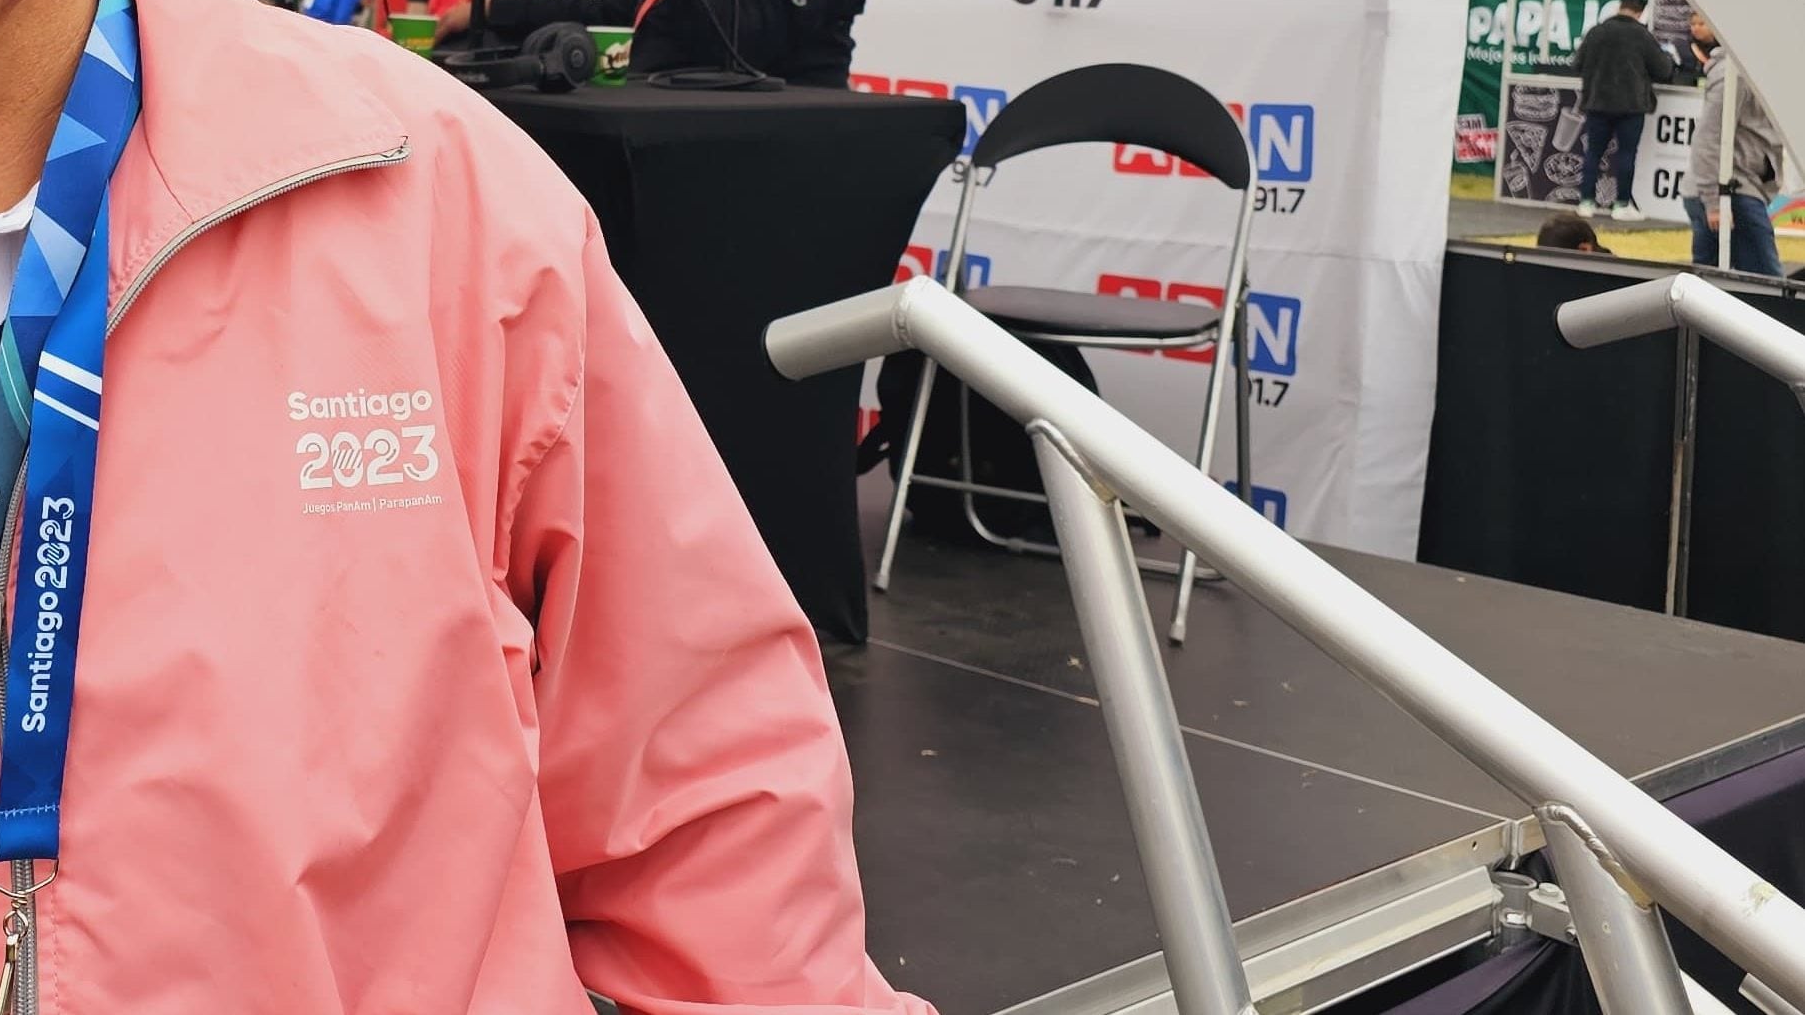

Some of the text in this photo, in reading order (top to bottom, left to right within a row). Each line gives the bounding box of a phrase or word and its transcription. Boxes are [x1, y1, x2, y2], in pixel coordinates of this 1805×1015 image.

[287, 388, 433, 421] Santiago
[1247, 377, 1290, 408] 1.7
[296, 424, 439, 490] 2023
